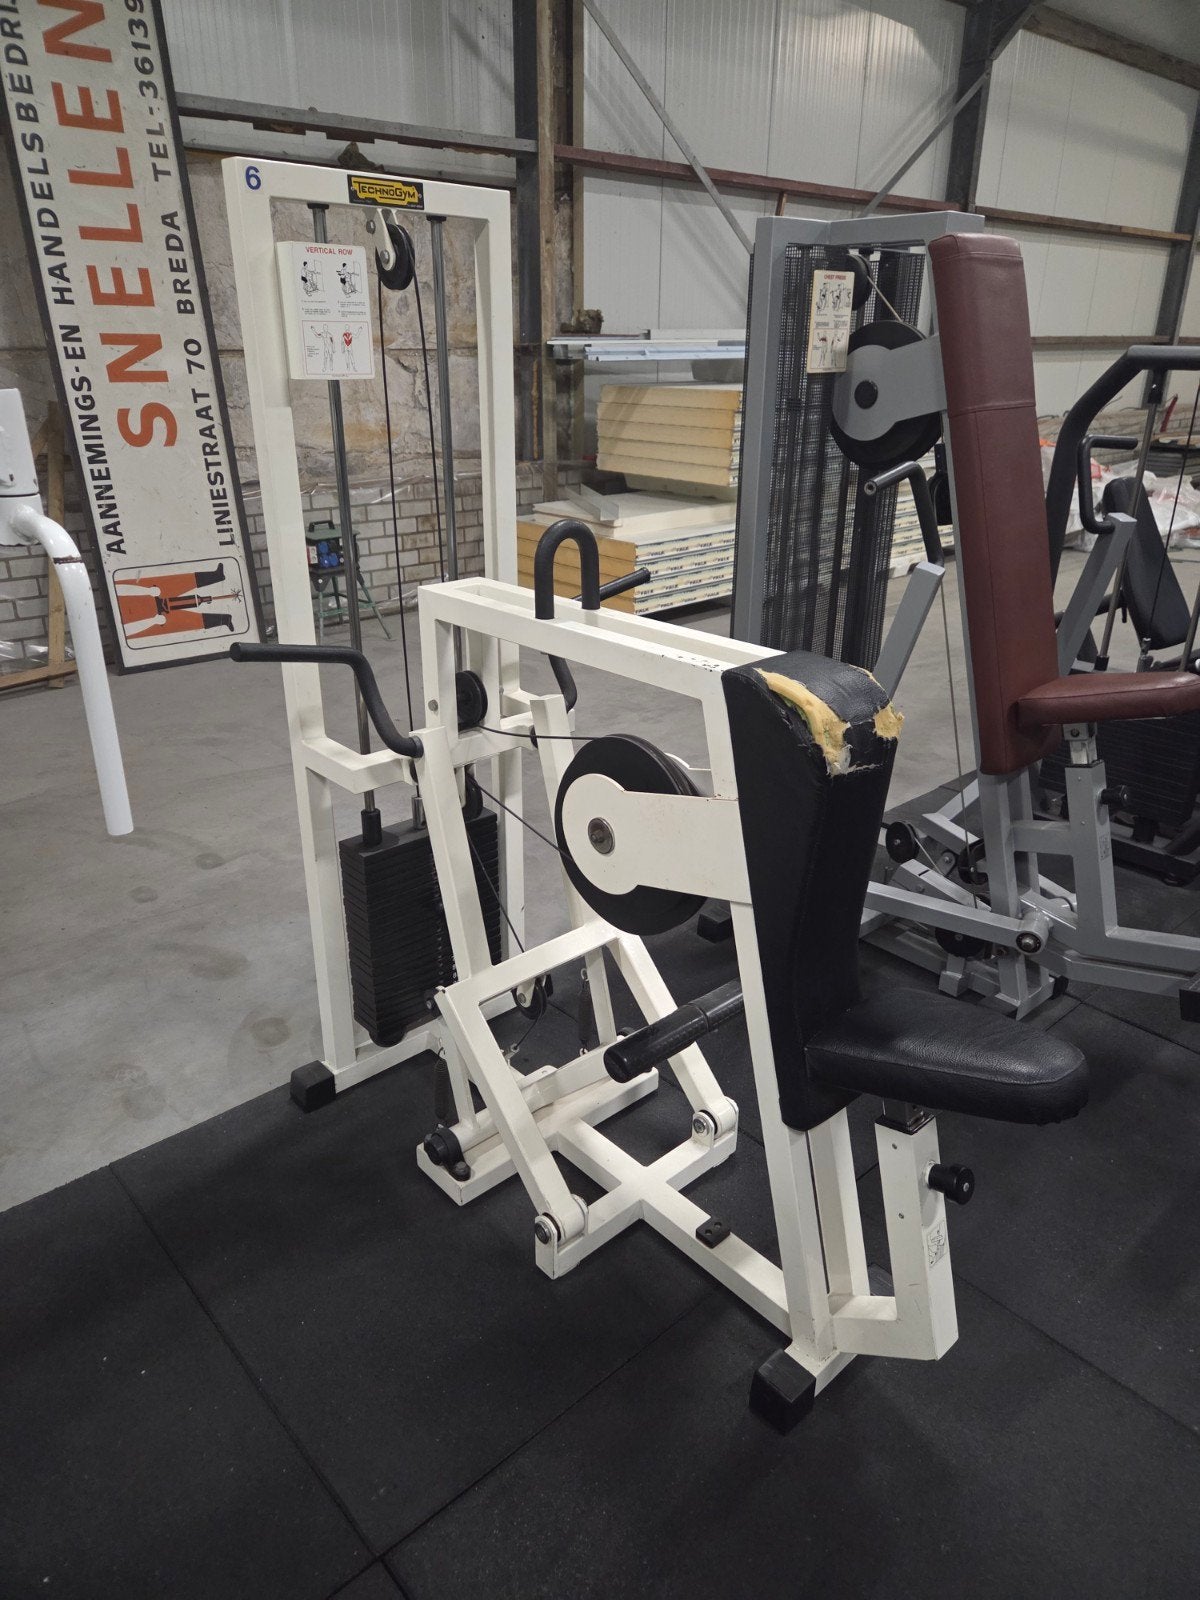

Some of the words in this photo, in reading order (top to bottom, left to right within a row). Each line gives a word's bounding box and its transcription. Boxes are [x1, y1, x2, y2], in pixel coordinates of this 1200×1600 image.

[0, 0, 76, 305] HANDELSBEDRI
[244, 165, 262, 191] 6
[36, 0, 178, 448] SNELLEN
[160, 210, 196, 315] BREDA
[305, 246, 337, 255] VERTICAL
[337, 248, 353, 256] ROW
[184, 338, 206, 374] 70
[192, 388, 236, 547] LINIESTRAAT
